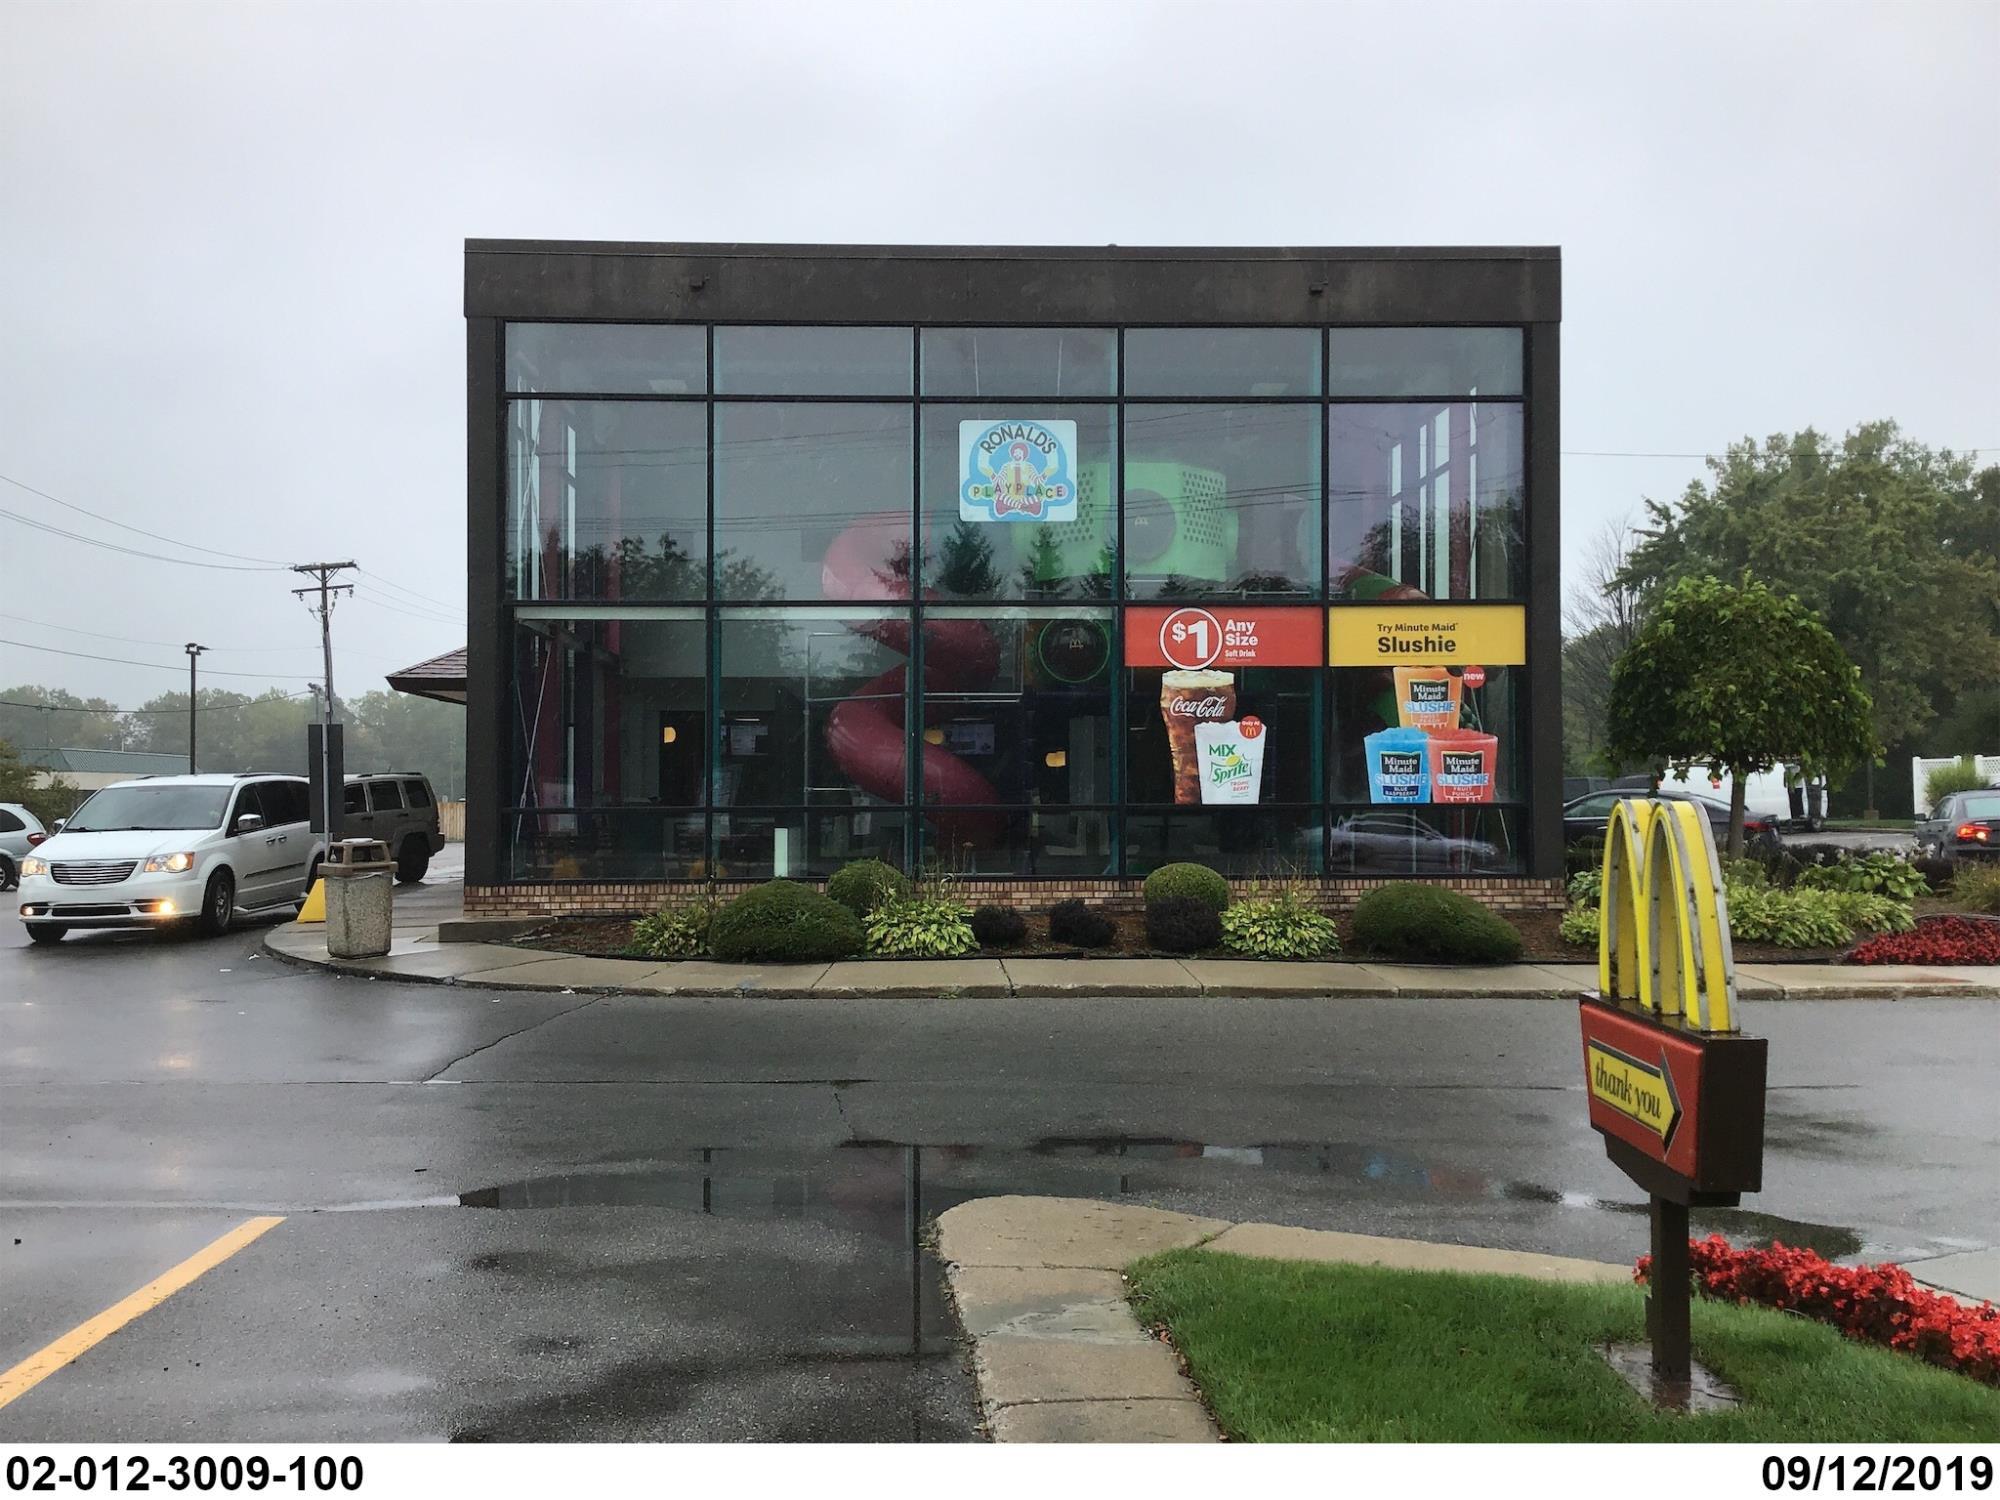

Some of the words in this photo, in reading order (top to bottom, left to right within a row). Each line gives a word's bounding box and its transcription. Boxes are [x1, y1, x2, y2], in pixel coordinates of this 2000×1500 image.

[980, 424, 1057, 455] RONALD'S
[973, 482, 1064, 499] PLAYPLACE
[1225, 619, 1256, 635] Any
[1377, 623, 1393, 634] Try
[1394, 623, 1430, 632] Minute
[1171, 620, 1209, 659] $1
[1225, 633, 1259, 647] Size
[1377, 635, 1457, 653] Slushie
[1463, 671, 1484, 682] new
[1413, 684, 1446, 693] Minute
[1418, 692, 1442, 700] Maid
[1404, 700, 1455, 713] SLUSHIE
[1209, 744, 1236, 757] MIX
[1384, 757, 1418, 765] Minute
[1446, 757, 1480, 765] Minute
[1212, 761, 1249, 784] Sprite
[1389, 765, 1413, 773] Maid
[1451, 765, 1475, 773] Maid
[1375, 774, 1428, 786] SLUSHIE
[1436, 773, 1489, 786] SLUSHIE
[1595, 1056, 1632, 1105] thank
[1635, 1086, 1662, 1120] you
